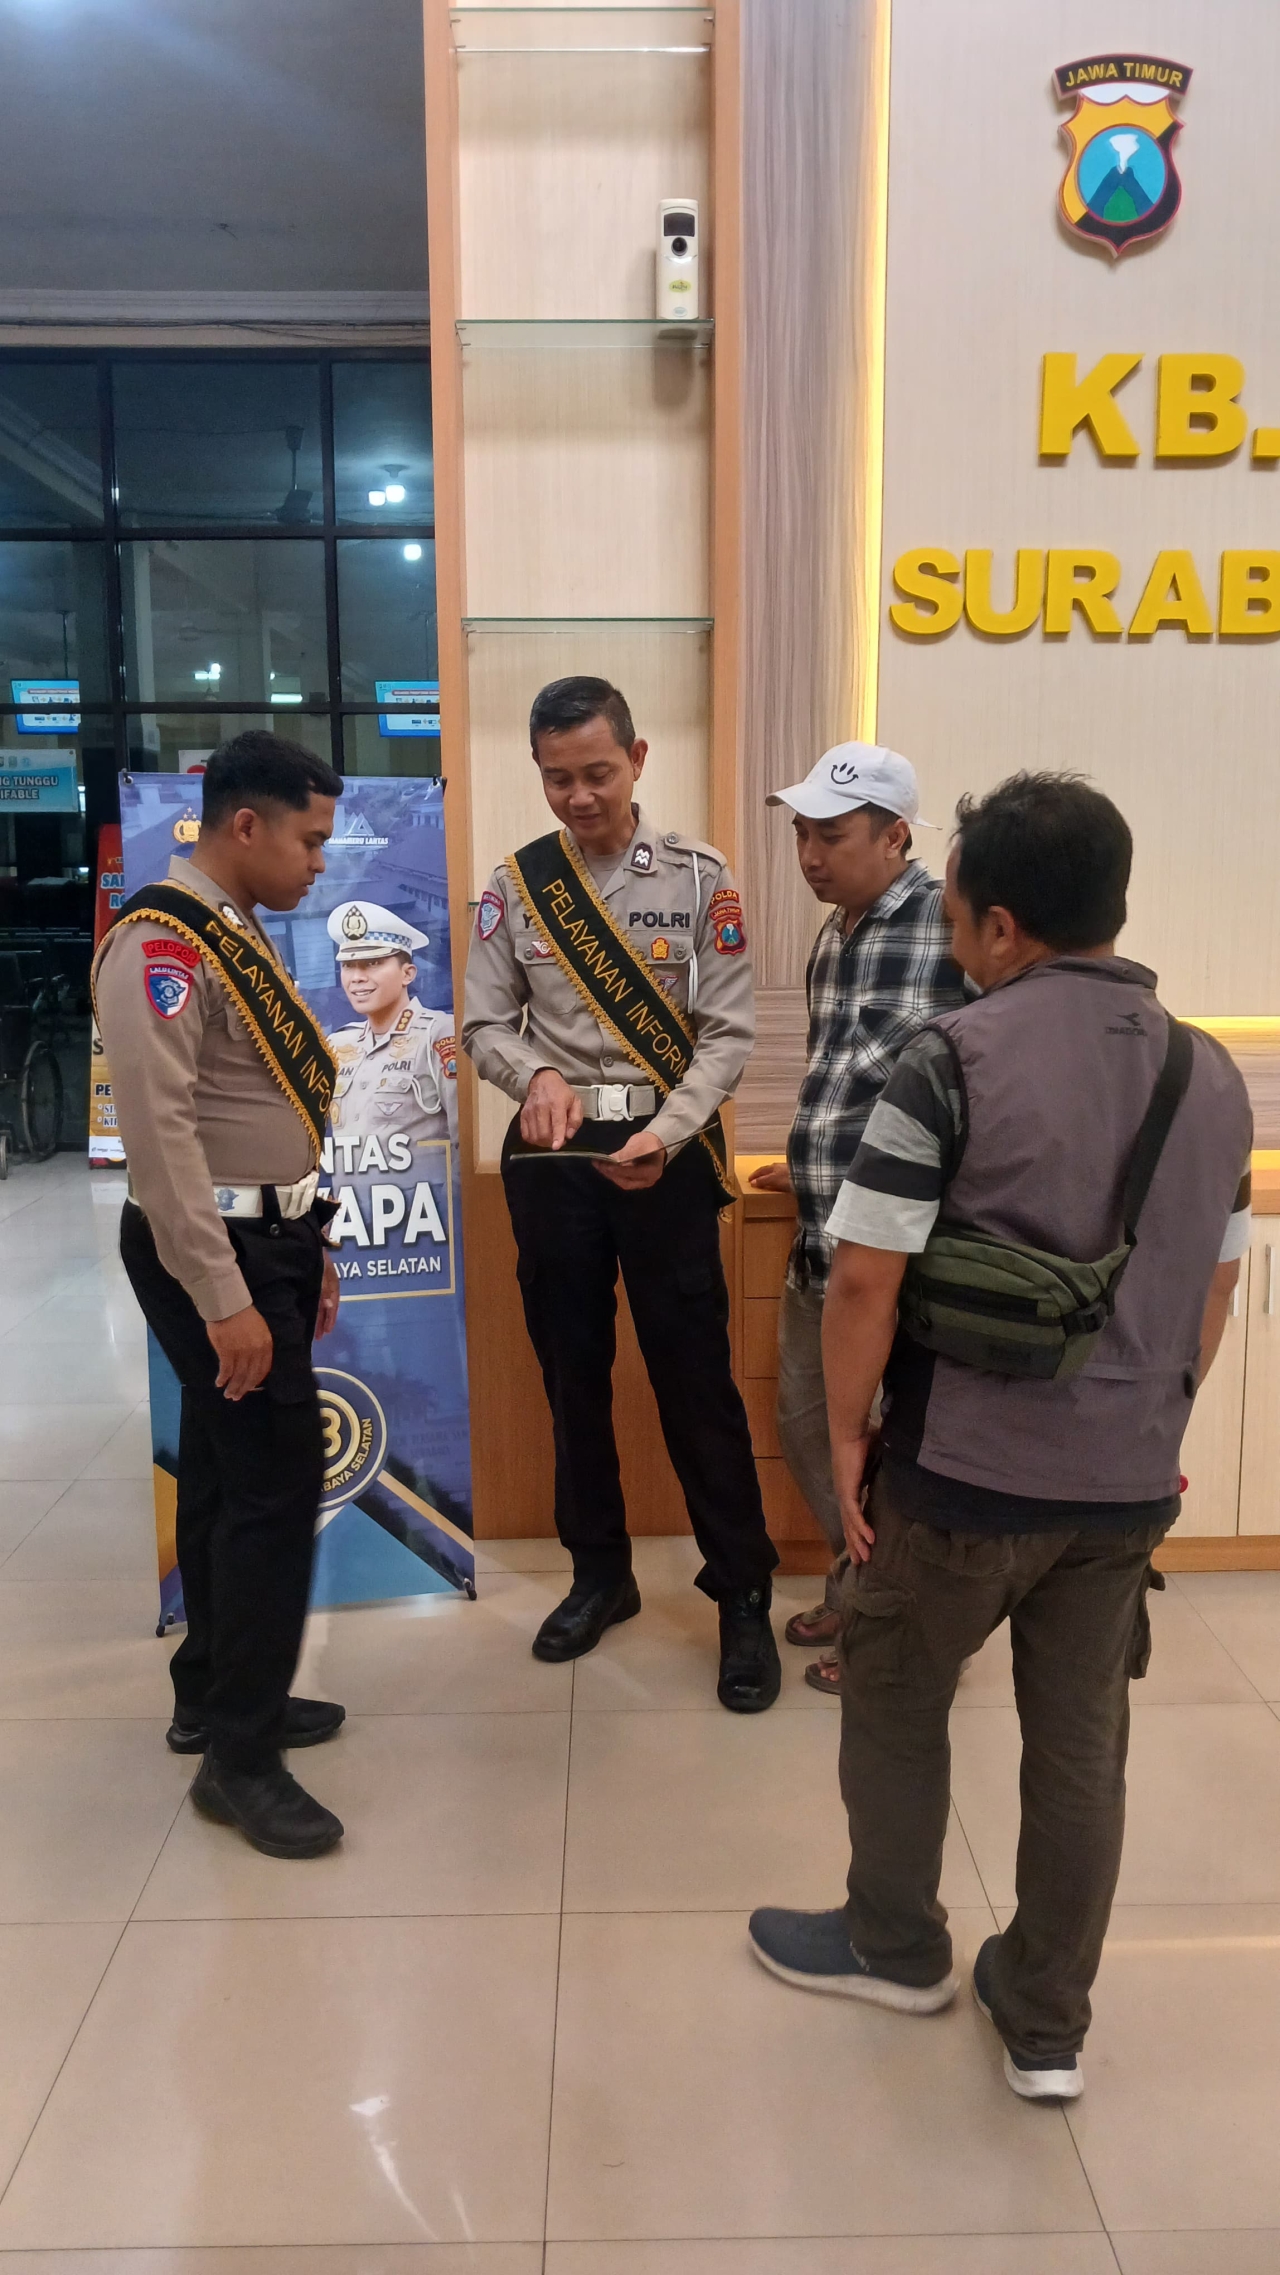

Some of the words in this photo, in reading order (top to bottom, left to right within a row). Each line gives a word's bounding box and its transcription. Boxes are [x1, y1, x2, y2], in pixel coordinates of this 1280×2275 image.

[1065, 62, 1118, 87] JAWA
[1123, 62, 1183, 88] TIMUR
[1038, 352, 1280, 460] KB.
[889, 547, 1280, 636] SURAB
[13, 776, 59, 786] TUNGGU
[1, 789, 39, 799] IFABLE
[711, 890, 738, 904] POLDA
[628, 911, 690, 929] POLRI
[147, 940, 196, 961] PELOPOR
[542, 878, 633, 1003] PELAYANAN
[205, 919, 308, 1059] PELAYANAN
[381, 1060, 412, 1074] POLRI
[316, 1181, 447, 1247] APA
[366, 1255, 442, 1277] SELATAN
[321, 1471, 354, 1493] BAYA
[351, 1417, 373, 1472] SELATAN
